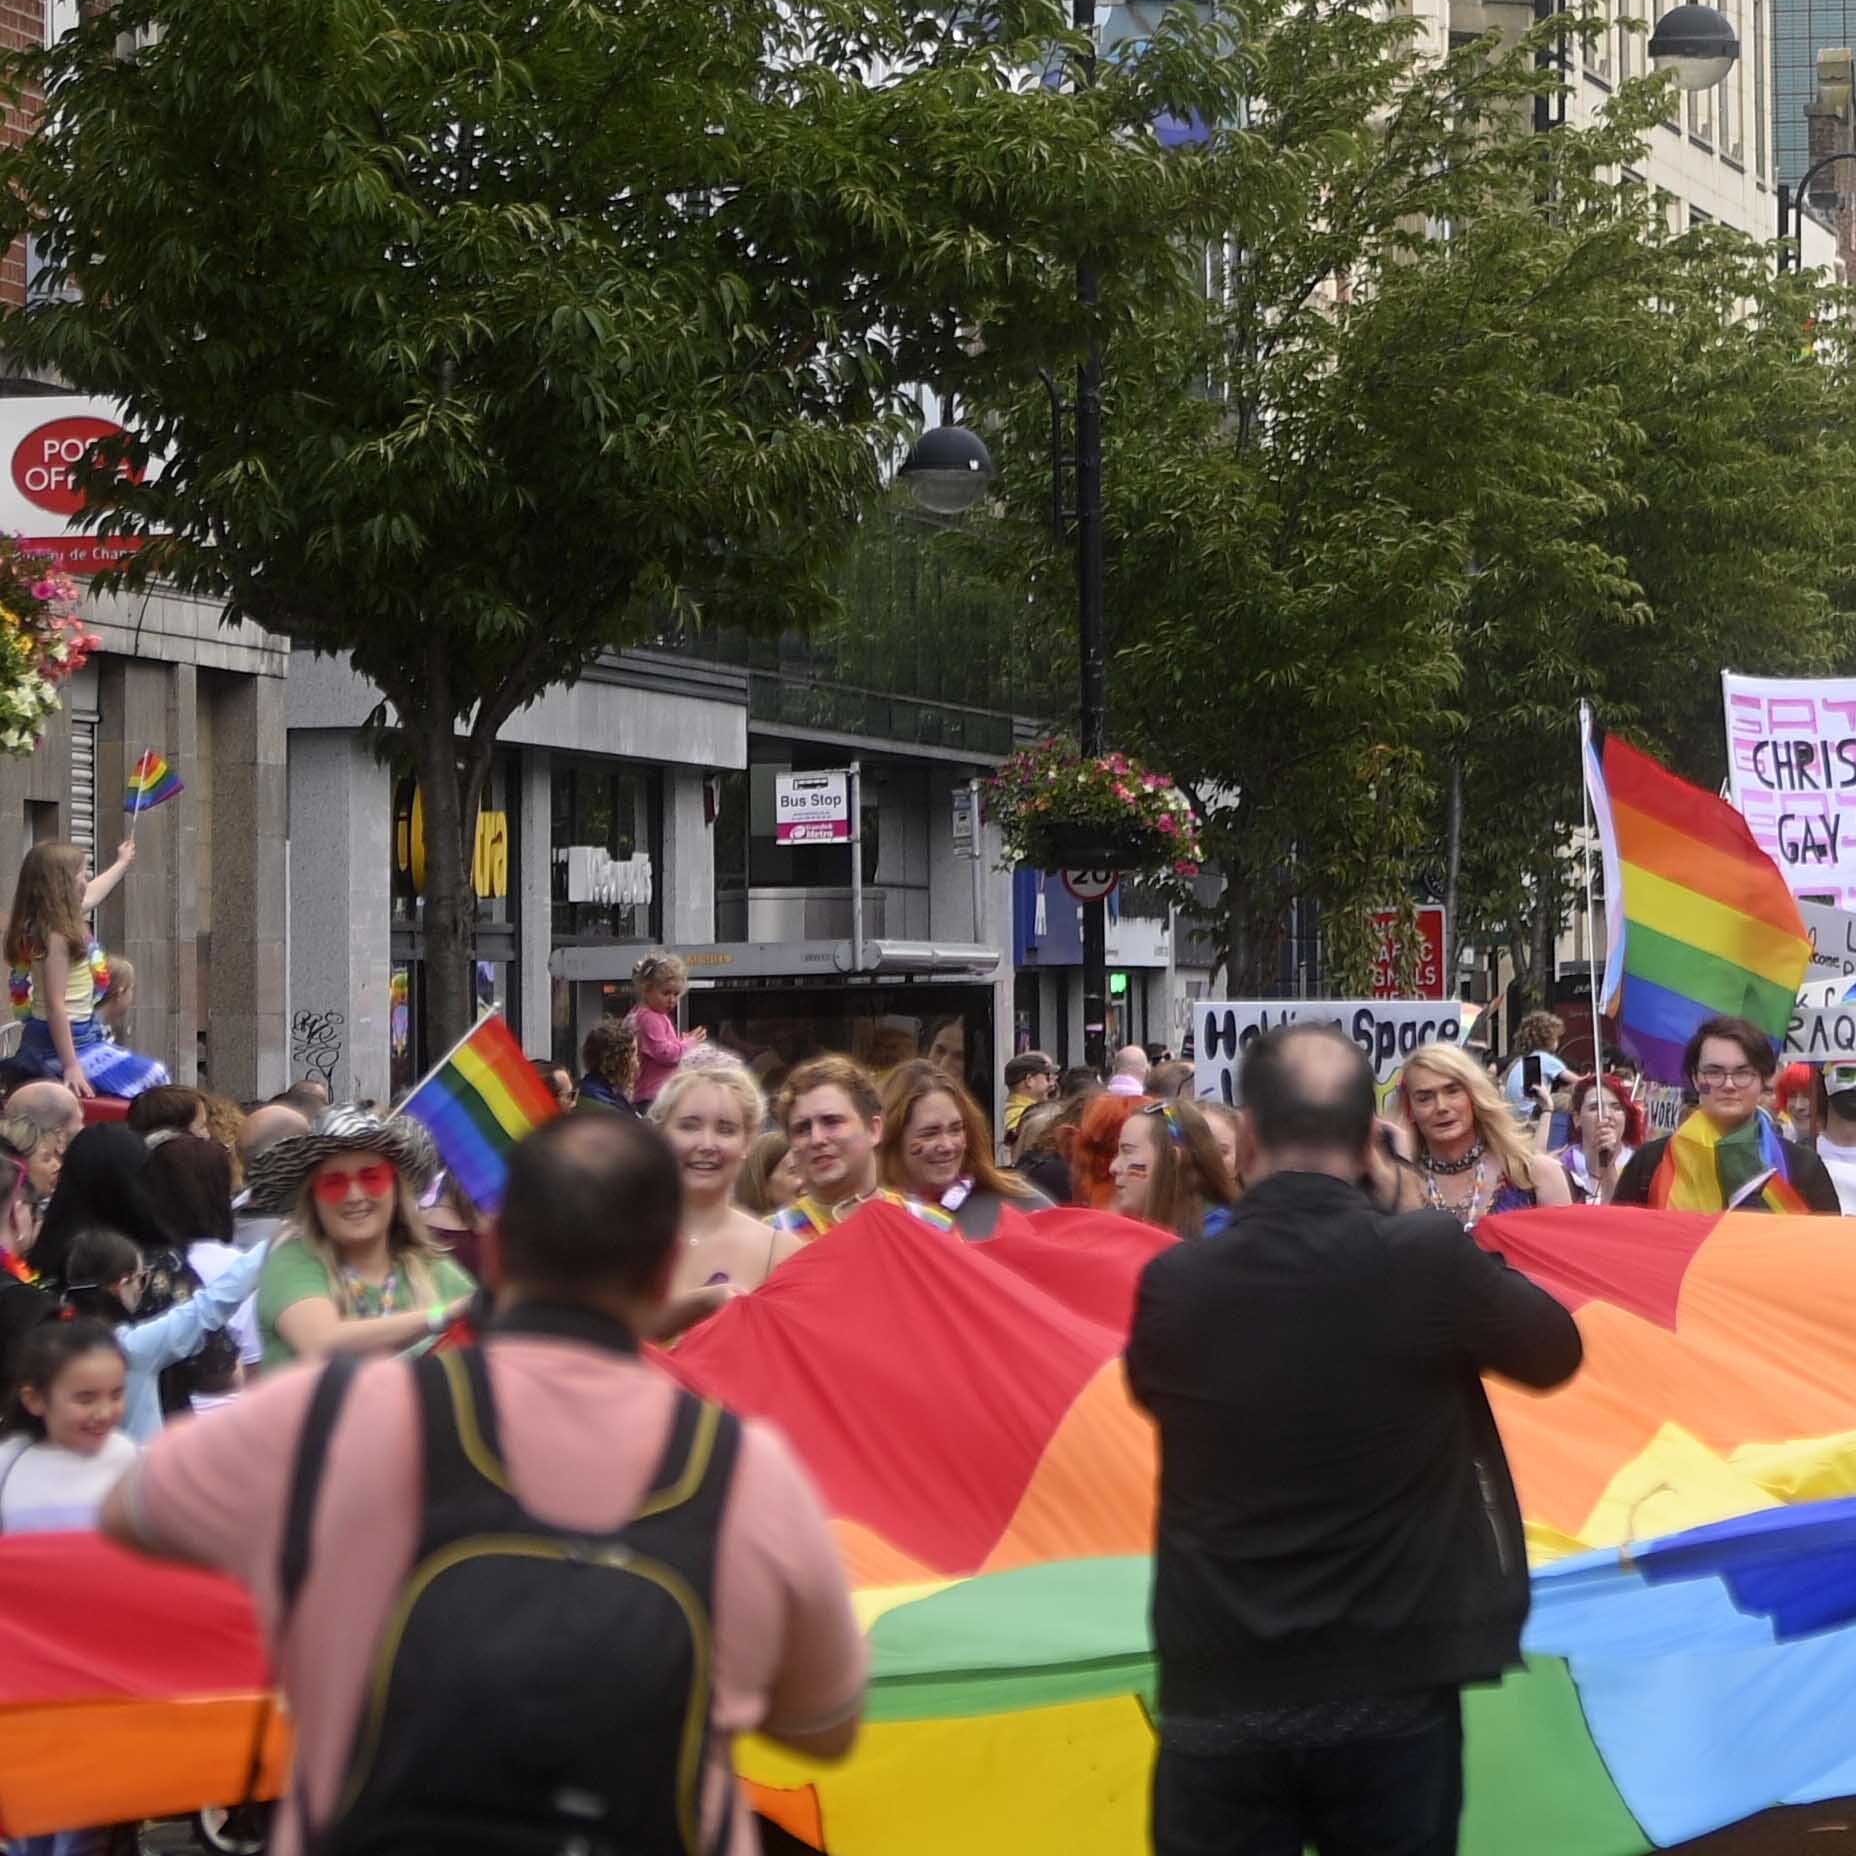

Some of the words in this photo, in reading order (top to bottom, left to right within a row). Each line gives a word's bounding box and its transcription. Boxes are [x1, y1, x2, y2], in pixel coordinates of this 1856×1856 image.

[44, 438, 98, 463] PO
[70, 548, 86, 560] de
[93, 547, 137, 560] Cha
[781, 795, 806, 807] Bus
[811, 793, 841, 808] Stop
[1778, 814, 1840, 864] GAY
[1353, 1008, 1460, 1074] Space
[1783, 1014, 1856, 1054] RAQ
